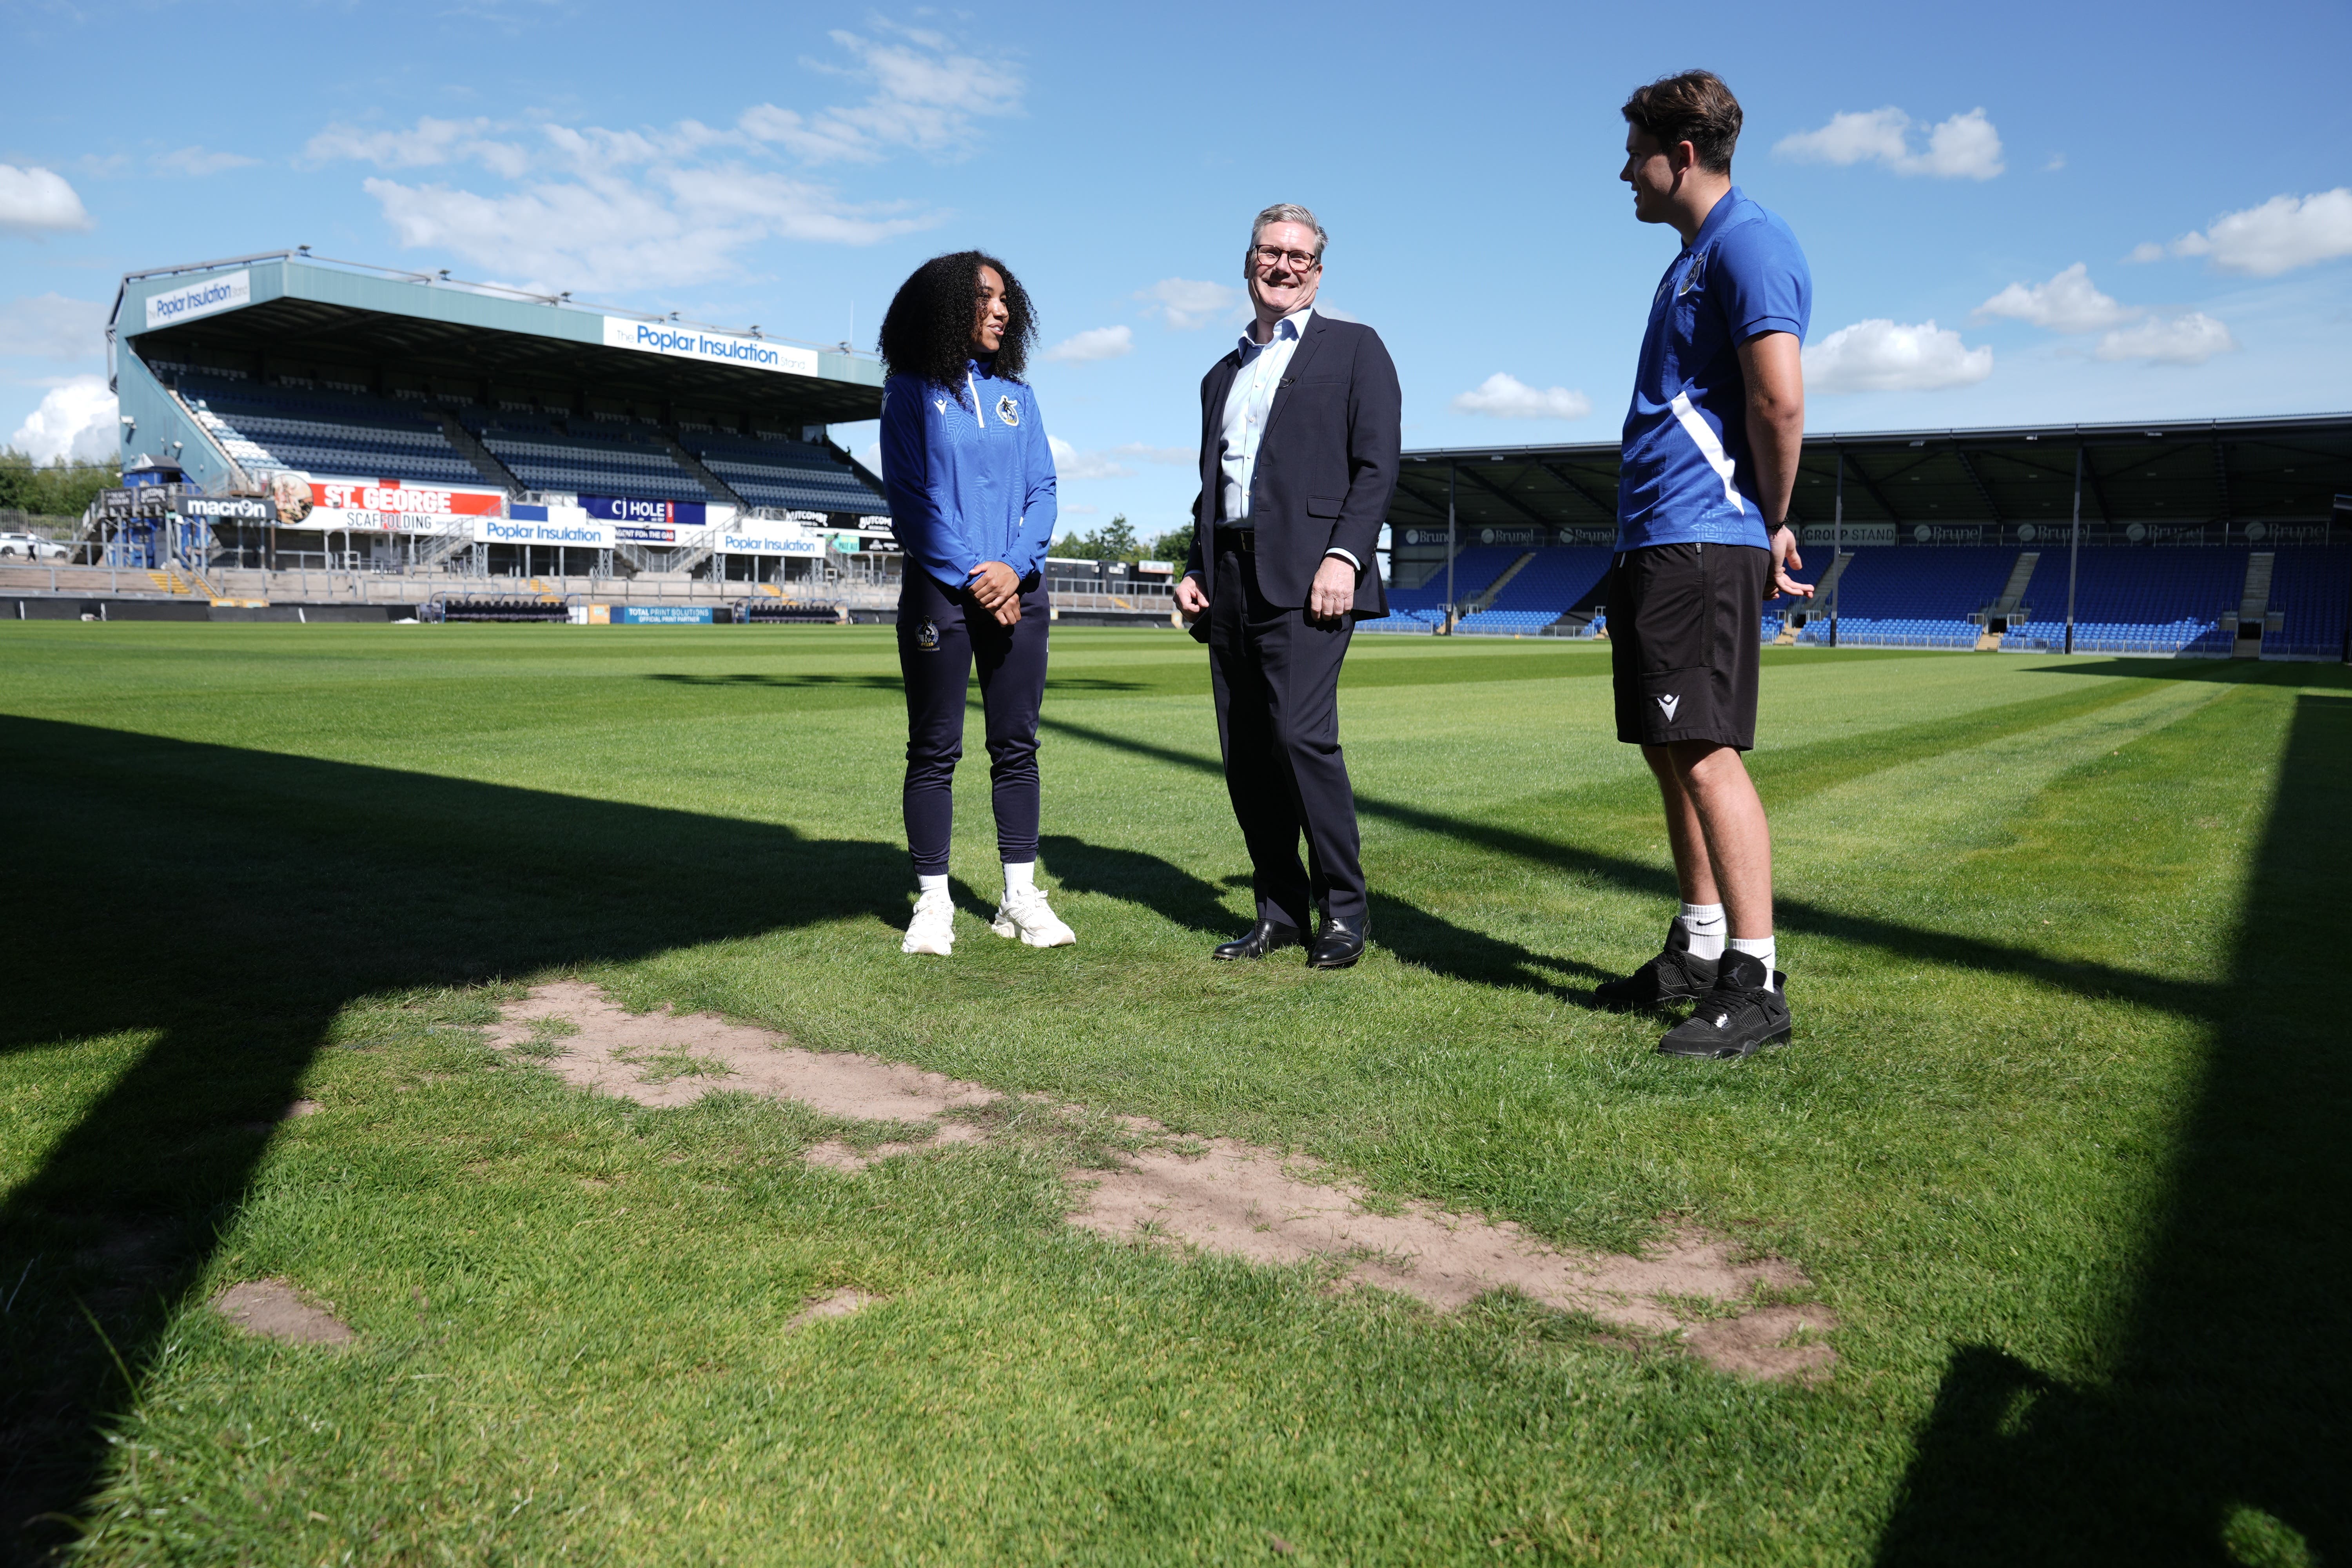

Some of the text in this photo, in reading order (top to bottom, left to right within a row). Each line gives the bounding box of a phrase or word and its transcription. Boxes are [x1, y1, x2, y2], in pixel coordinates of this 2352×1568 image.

[157, 296, 184, 318] Poplar
[187, 283, 231, 310] Insulation
[617, 325, 805, 370] The Poplar Insulation Stand
[324, 485, 452, 514] ST. GEORGE
[187, 499, 267, 517] macron
[630, 501, 665, 517] HOLE
[347, 512, 432, 529] SCAFFOLDING
[858, 515, 892, 529] BUTCOM
[487, 522, 601, 542] Poplar Insulation
[1495, 528, 1534, 542] Brunel
[1575, 528, 1615, 542] Brunel
[1851, 529, 1894, 541] STAND
[1933, 525, 1982, 540] Brunel
[726, 535, 815, 552] Poplar Insulation
[628, 608, 709, 616] TOTAL PRINT SOLUTIONS
